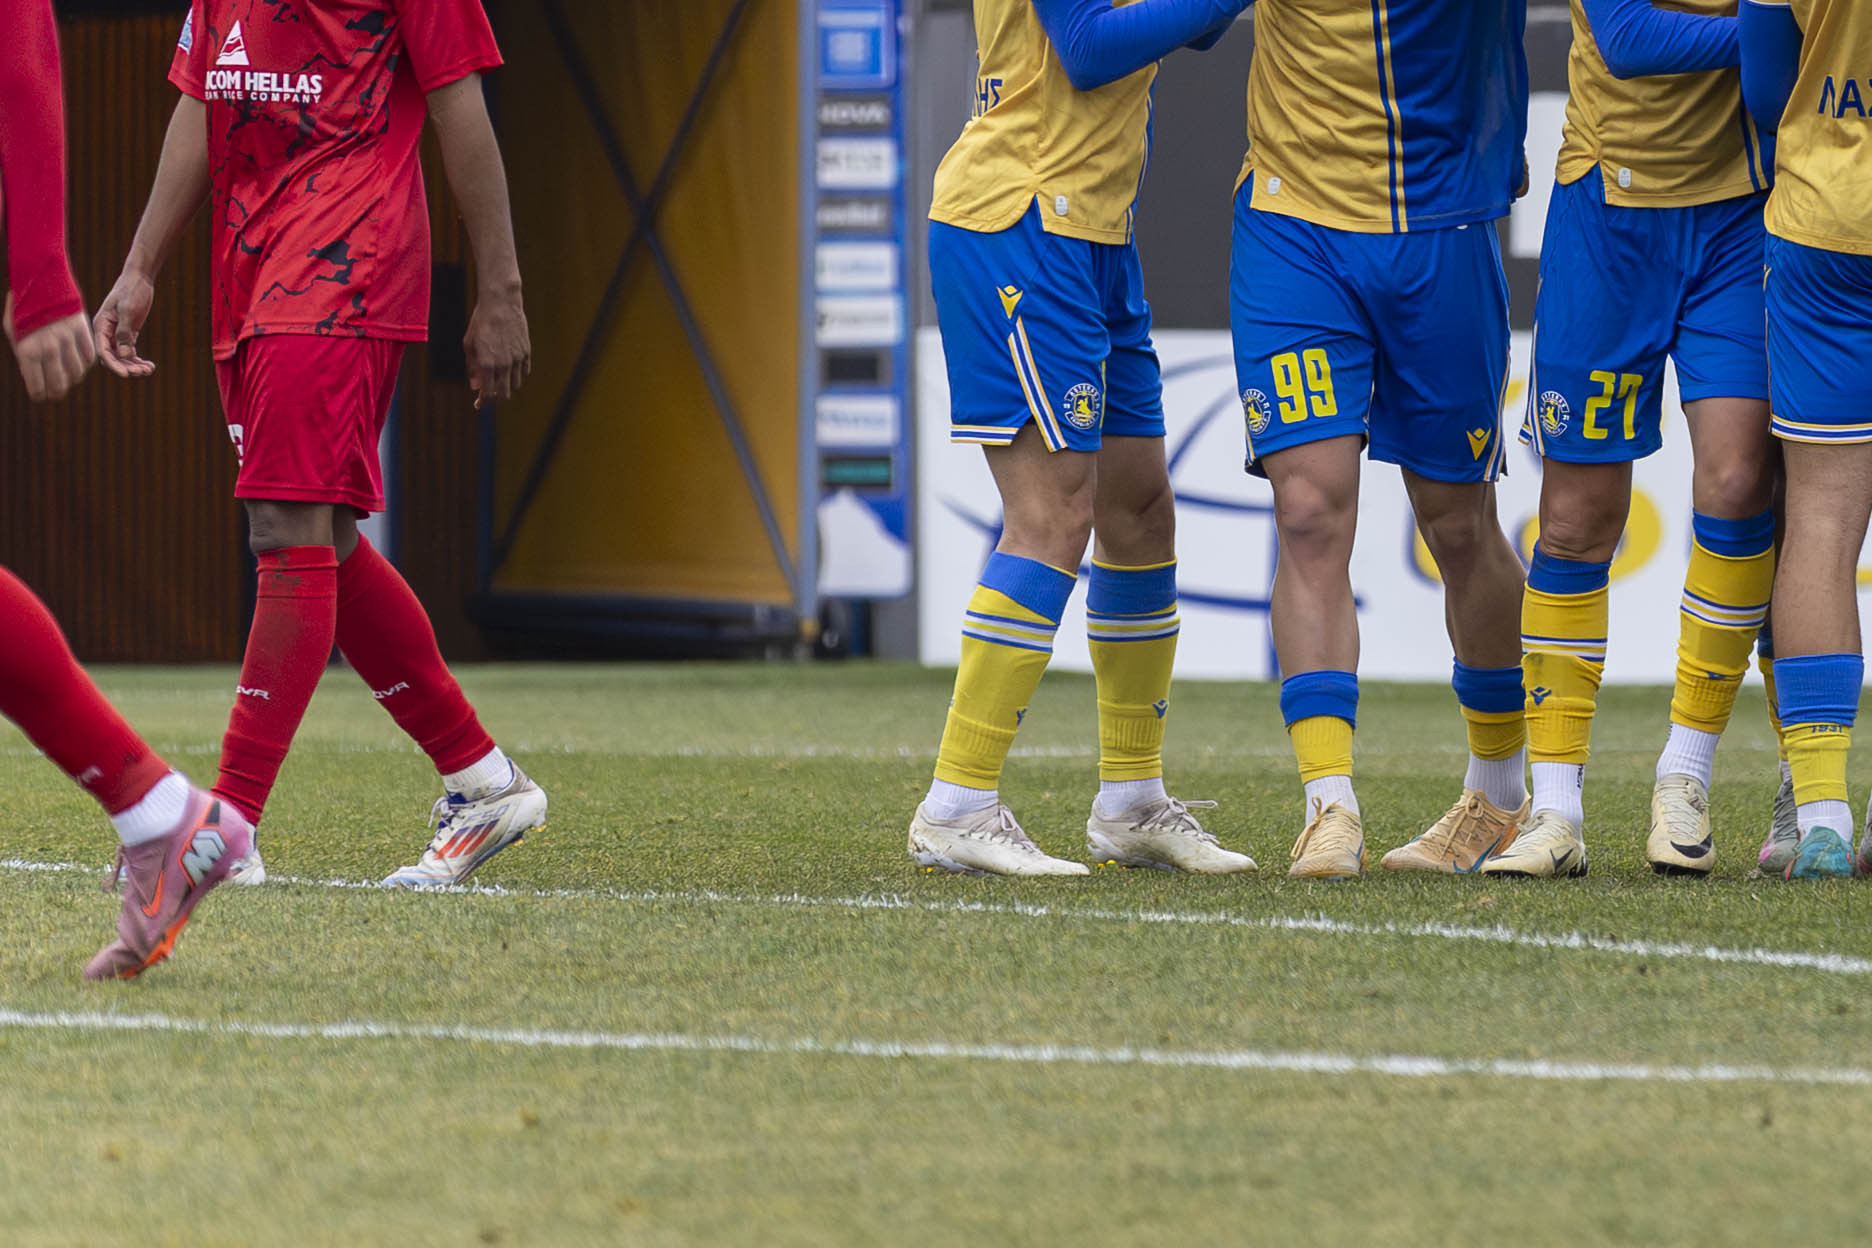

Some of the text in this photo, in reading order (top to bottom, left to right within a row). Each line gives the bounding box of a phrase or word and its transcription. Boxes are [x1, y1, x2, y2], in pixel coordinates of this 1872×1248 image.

[205, 71, 322, 94] ICOM HELLAS
[250, 92, 321, 104] COMPANY
[1271, 348, 1338, 424] 99
[1583, 370, 1643, 440] 27
